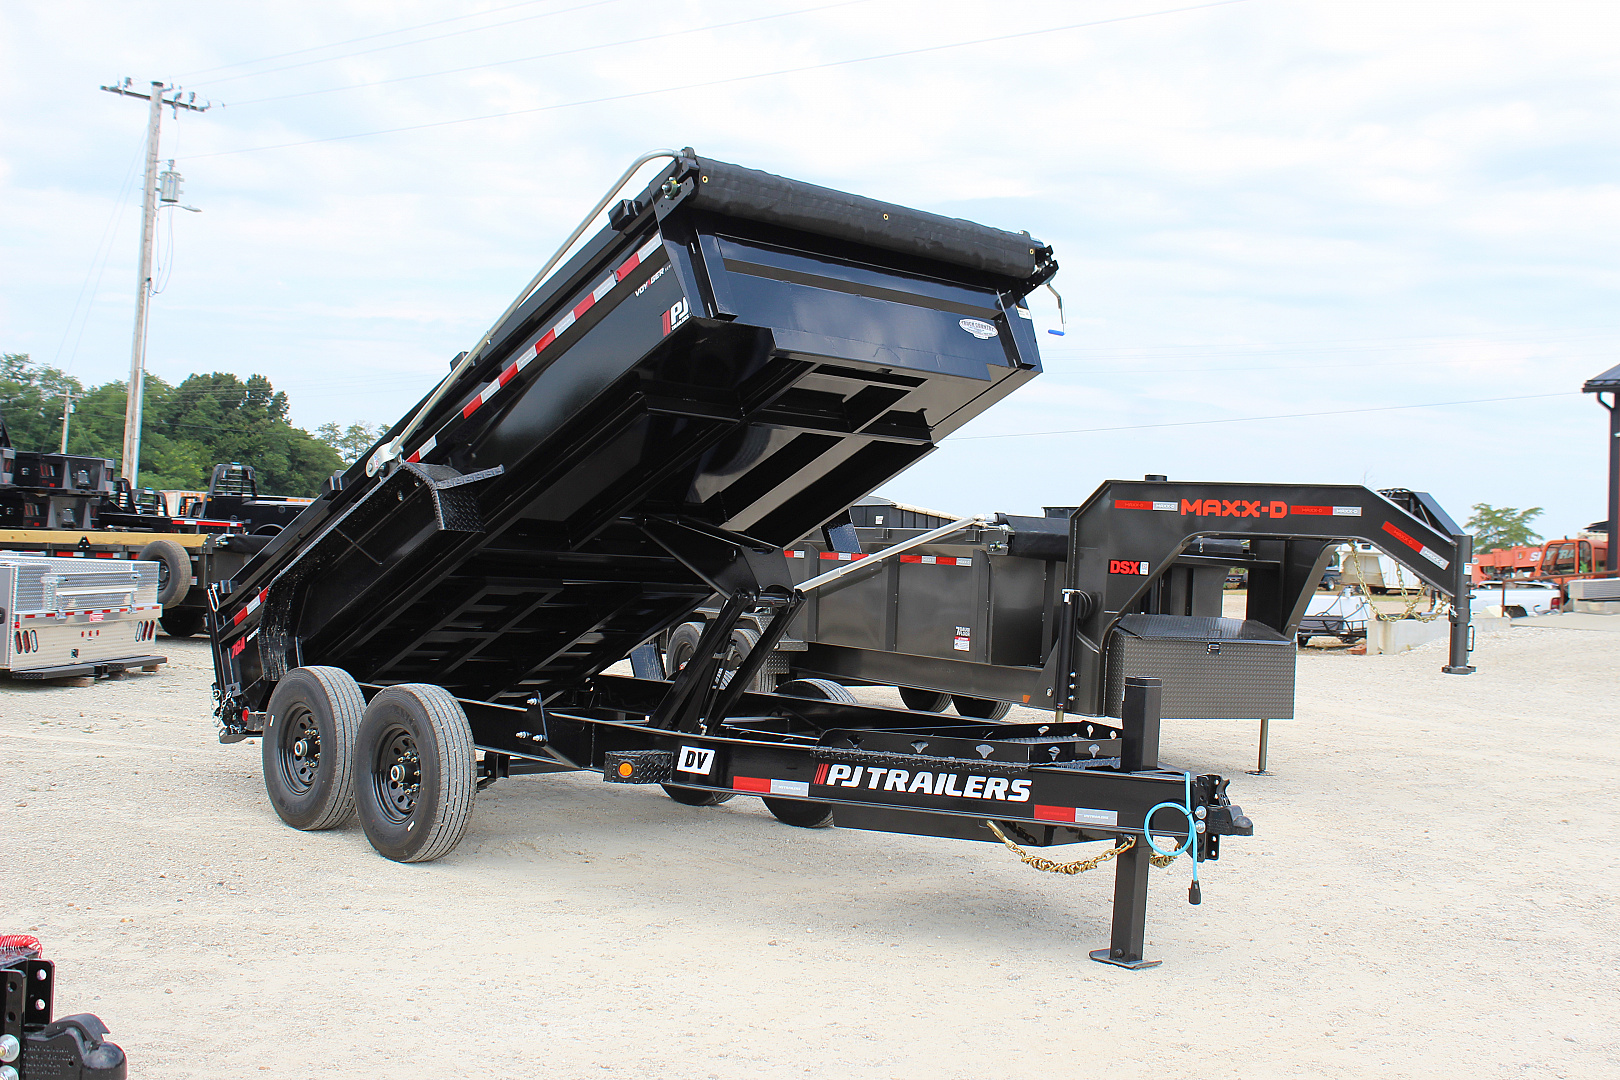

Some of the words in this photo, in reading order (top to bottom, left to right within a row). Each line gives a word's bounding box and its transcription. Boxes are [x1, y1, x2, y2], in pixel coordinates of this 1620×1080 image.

[634, 268, 665, 297] VOYAGER
[670, 296, 689, 326] PJ
[1180, 498, 1288, 518] MAXX-D
[1110, 560, 1140, 575] DSX
[684, 750, 708, 770] DV
[826, 764, 864, 788] PJ
[865, 766, 1033, 802] TRAILERS
